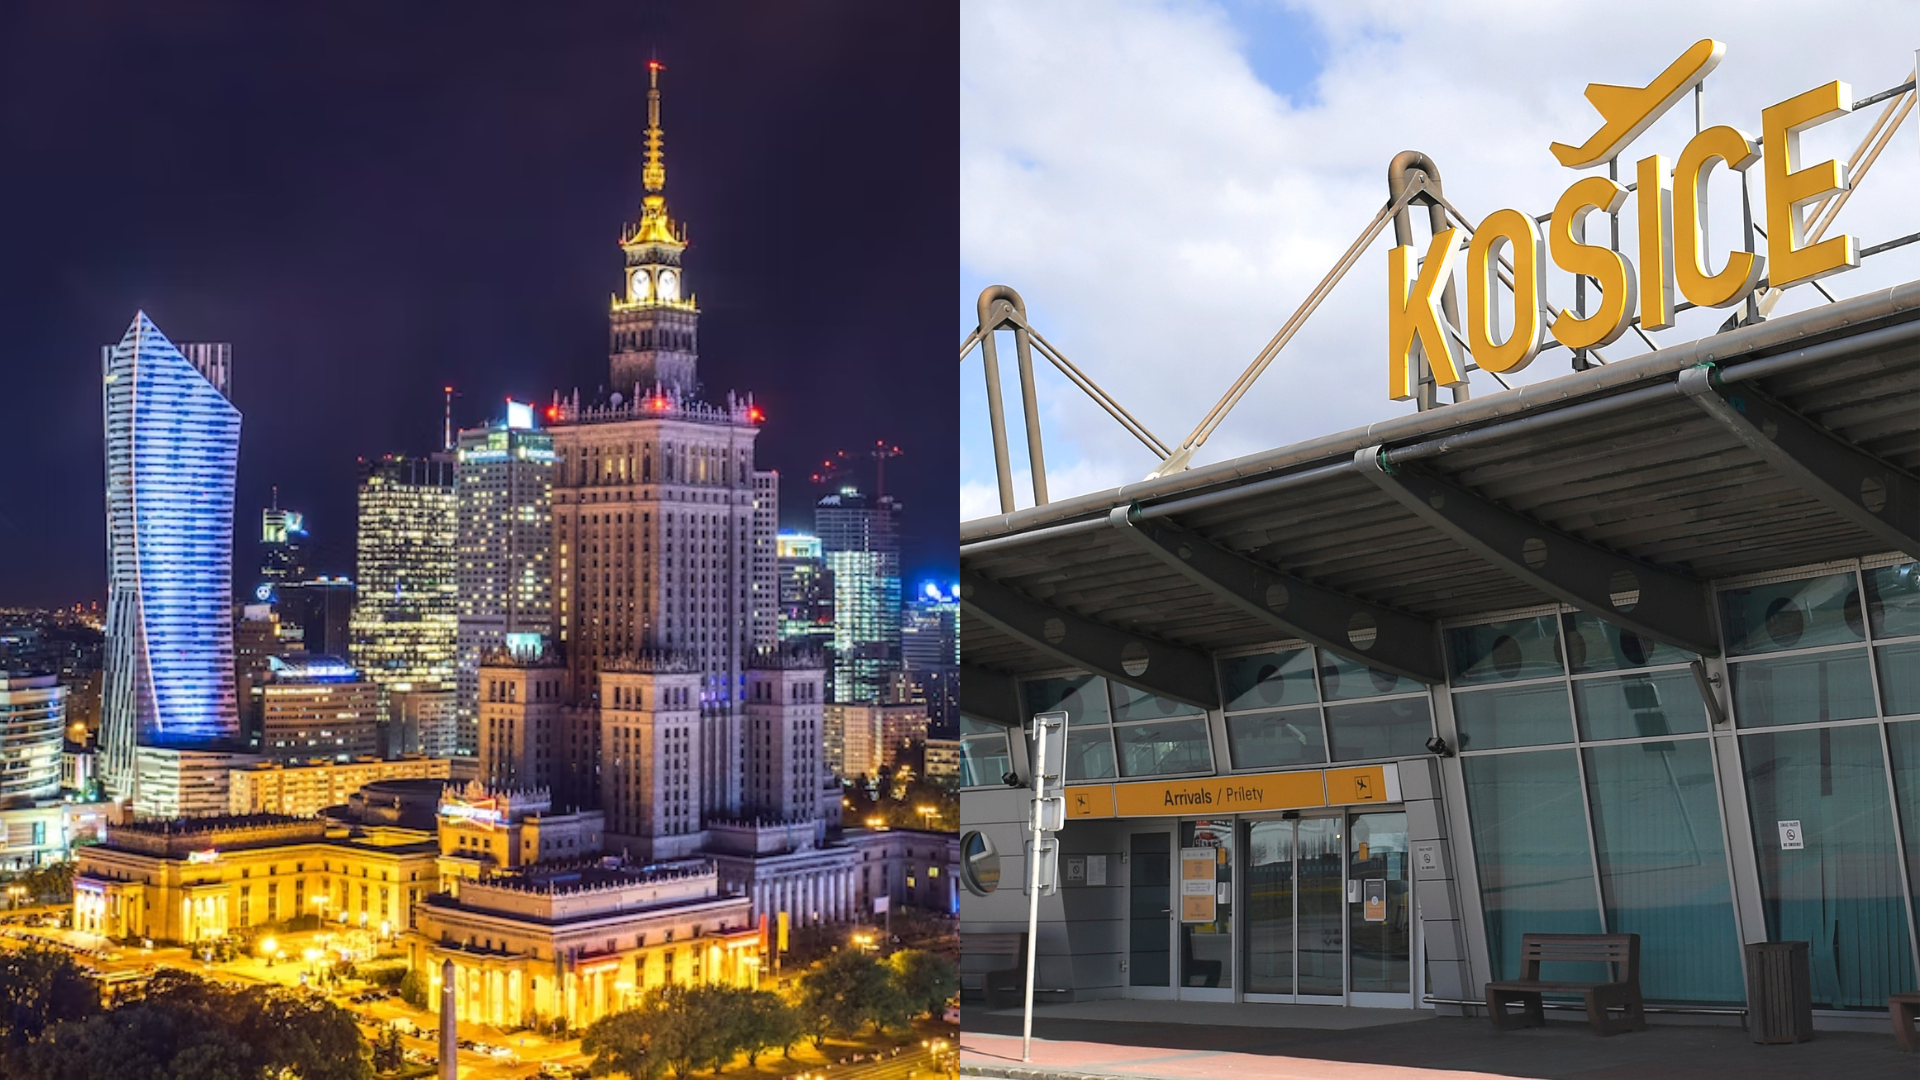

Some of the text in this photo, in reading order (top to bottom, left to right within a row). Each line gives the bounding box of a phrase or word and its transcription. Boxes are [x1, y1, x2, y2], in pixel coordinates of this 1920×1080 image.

[1164, 786, 1264, 806] Arrivals / Prílety
